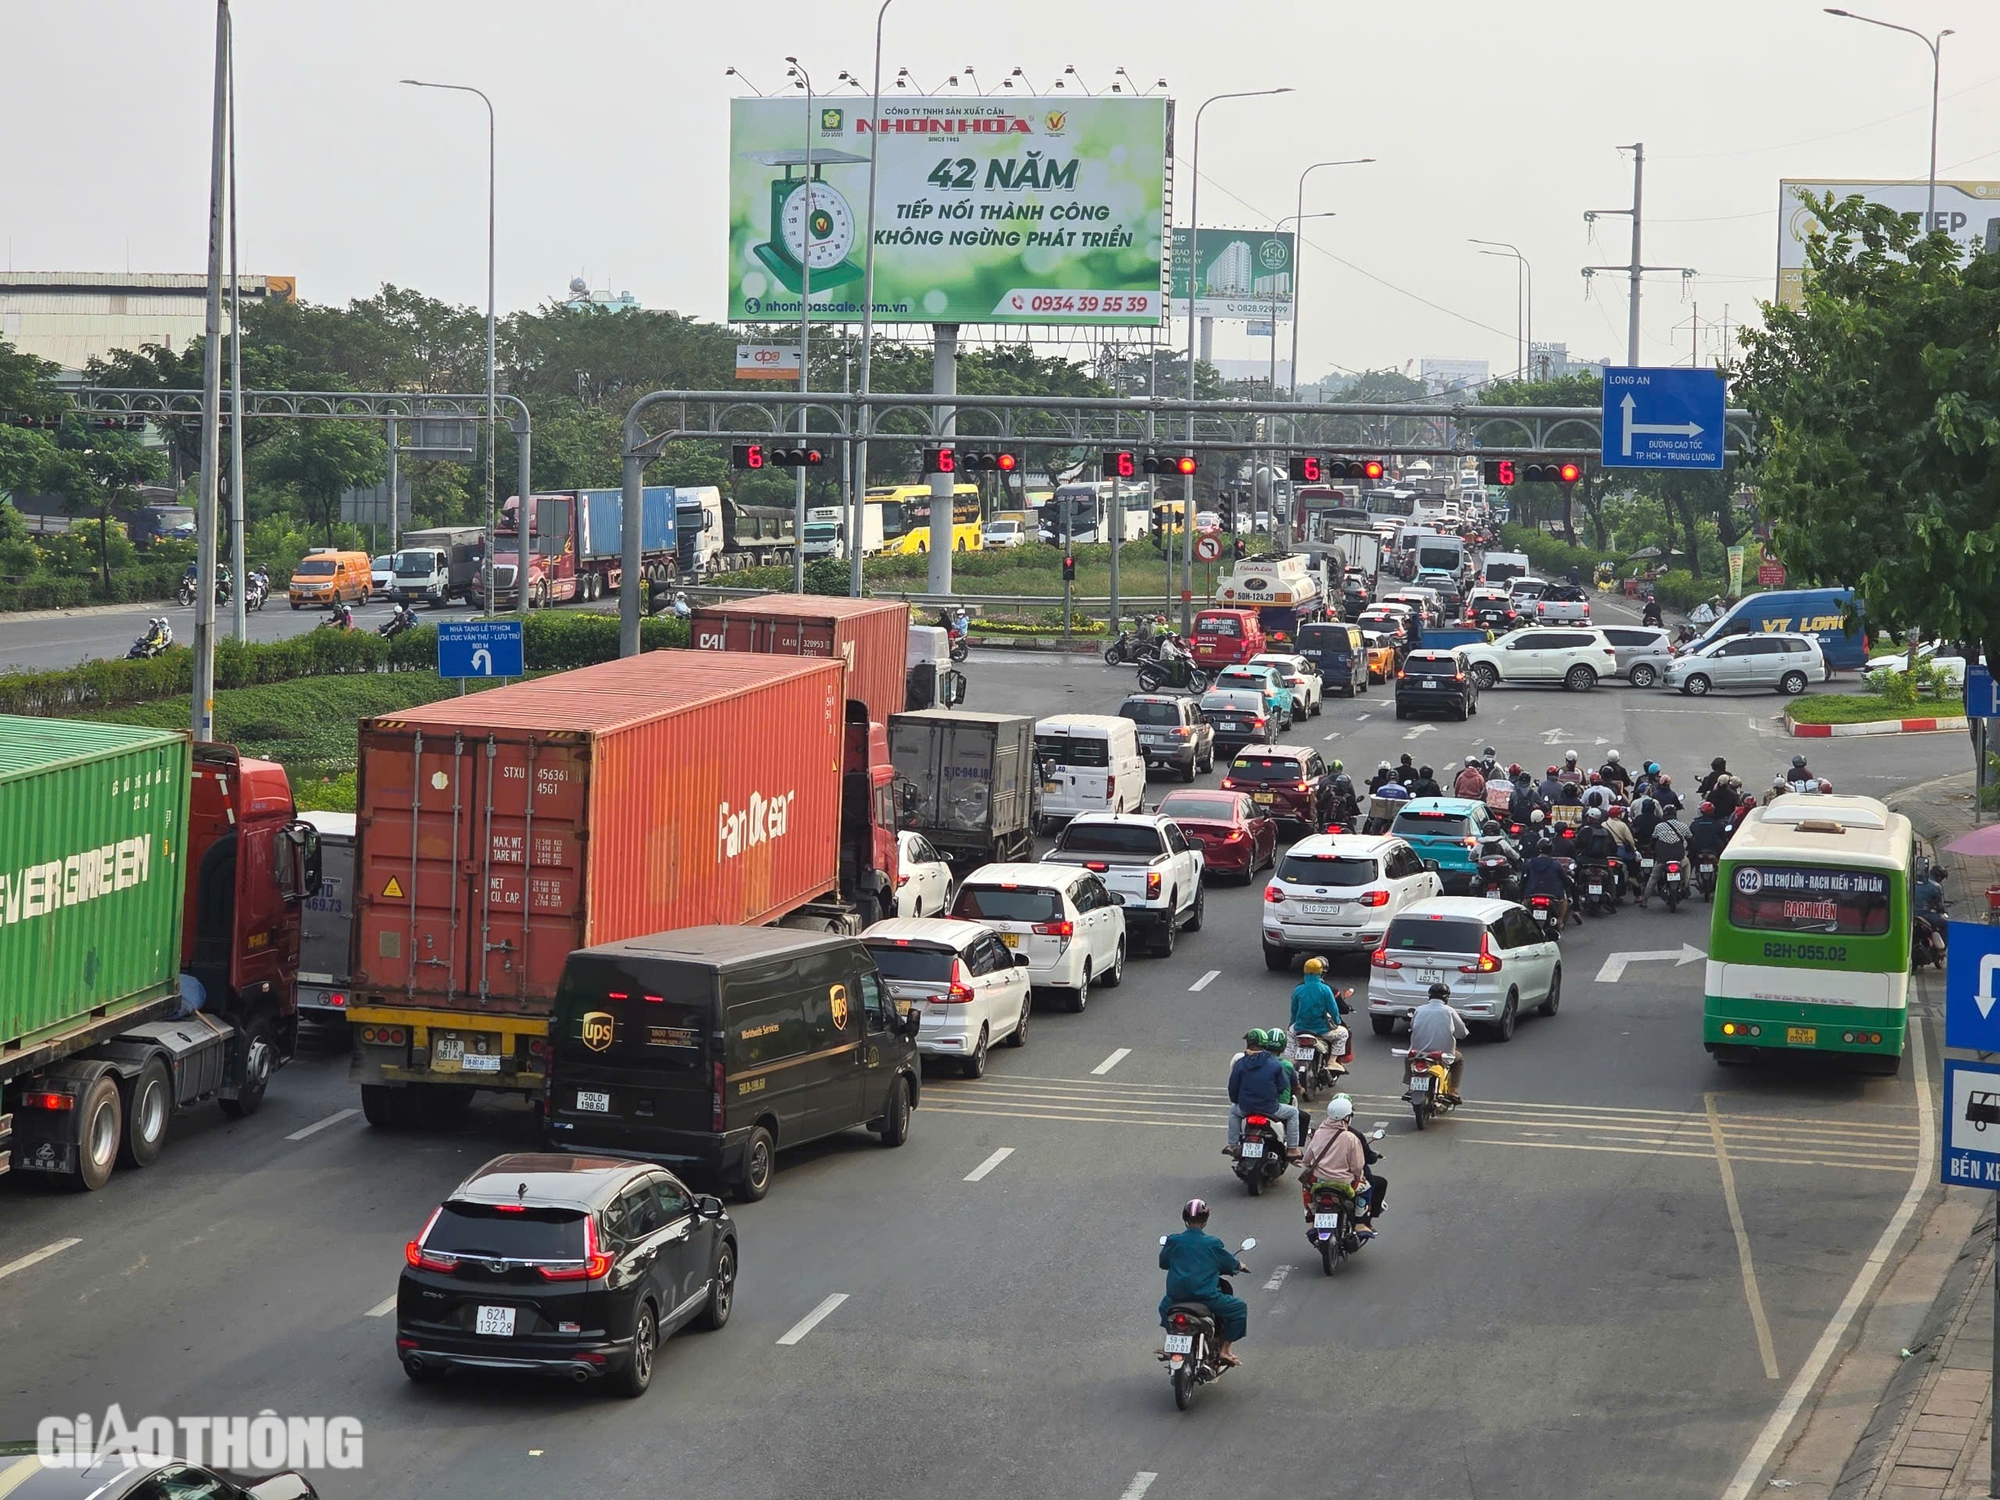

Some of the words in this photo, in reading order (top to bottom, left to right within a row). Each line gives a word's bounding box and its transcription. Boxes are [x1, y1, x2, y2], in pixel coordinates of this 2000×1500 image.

[912, 107, 922, 116] TY
[923, 107, 943, 116] TNHH
[927, 157, 978, 191] 42
[984, 150, 1080, 192] NĂM
[896, 197, 933, 219] TIẾP
[938, 198, 974, 220] NỐI
[980, 202, 1044, 220] THÀNH
[1050, 202, 1110, 221] CÔNG
[873, 226, 944, 245] KHÔNG
[950, 228, 1021, 246] NGỪNG
[1026, 228, 1076, 247] PHÁT
[1081, 224, 1133, 247] TRIỂN
[1031, 295, 1074, 312] 0934
[1078, 296, 1099, 312] 39
[1102, 296, 1123, 312] 55
[1125, 297, 1148, 313] 39
[1609, 376, 1634, 385] LONG
[1636, 376, 1650, 385] AN
[1674, 441, 1688, 449] CAO
[748, 445, 762, 469] 6
[939, 449, 954, 472] 6
[1118, 452, 1133, 476] 6
[1636, 452, 1645, 460] TP.
[1646, 452, 1661, 460] HCM
[1668, 452, 1690, 461] TRUNG
[1304, 458, 1319, 481] 6
[1500, 461, 1515, 484] 6
[1237, 593, 1274, 601] 50H-124.29
[700, 633, 723, 650] CAI
[782, 638, 797, 647] CAIU
[803, 640, 823, 648] 320953
[504, 766, 525, 779] STXU
[537, 768, 569, 781] 456361
[537, 783, 558, 795] 45G1
[493, 850, 510, 862] TARE
[0, 834, 150, 929] VERGREEN
[491, 878, 504, 889] NET
[1740, 873, 1758, 891] 622
[1763, 873, 1774, 887] BX
[1809, 875, 1829, 891] RẠCH
[1854, 875, 1868, 892] TÂN
[491, 892, 503, 903] CU.
[505, 892, 521, 904] CAP.
[305, 899, 342, 913] 469.73
[1784, 900, 1812, 922] RẠCH
[1763, 941, 1847, 962] 62H-055.02
[585, 1022, 611, 1046] ups
[444, 1038, 459, 1050] 51R
[584, 1093, 603, 1102] 50LD
[581, 1101, 605, 1111] 198.60
[1951, 1152, 1980, 1180] BẾN
[487, 1309, 506, 1321] 62A
[480, 1320, 512, 1334] 132.28
